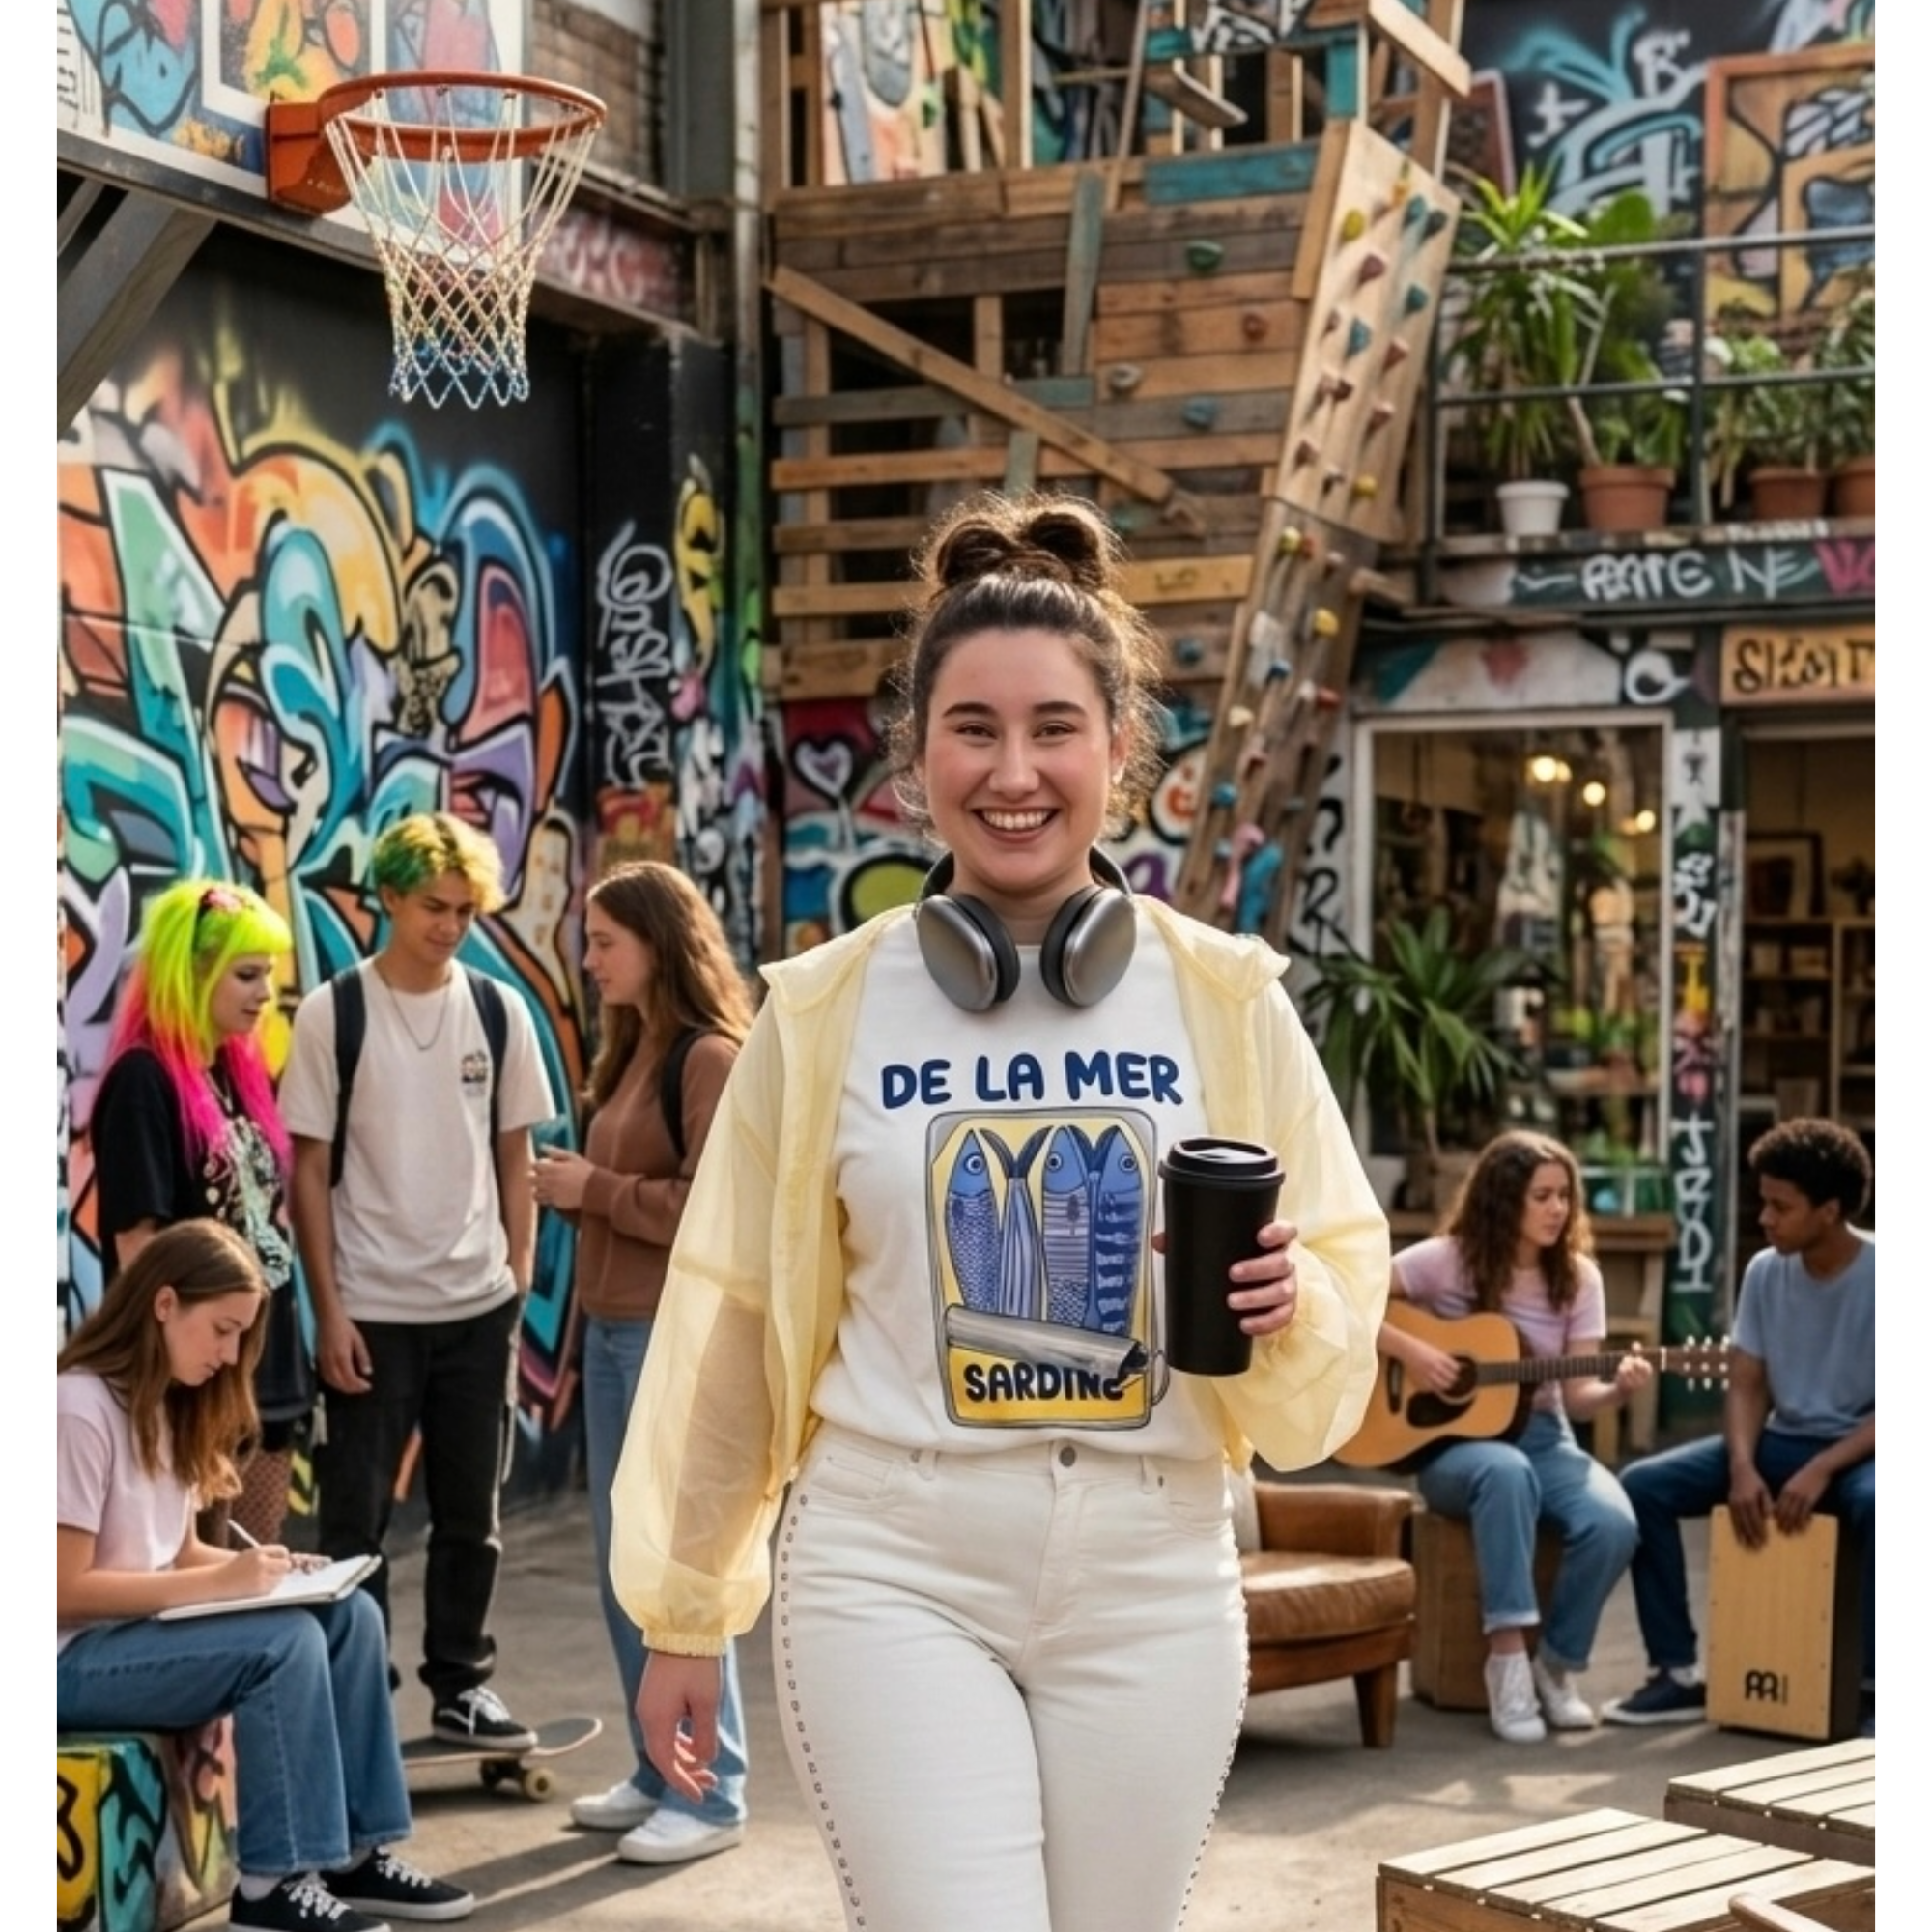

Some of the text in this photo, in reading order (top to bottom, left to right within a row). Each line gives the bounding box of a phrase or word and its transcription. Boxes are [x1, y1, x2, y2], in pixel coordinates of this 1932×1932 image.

[881, 1049, 1183, 1109] DE LA MER
